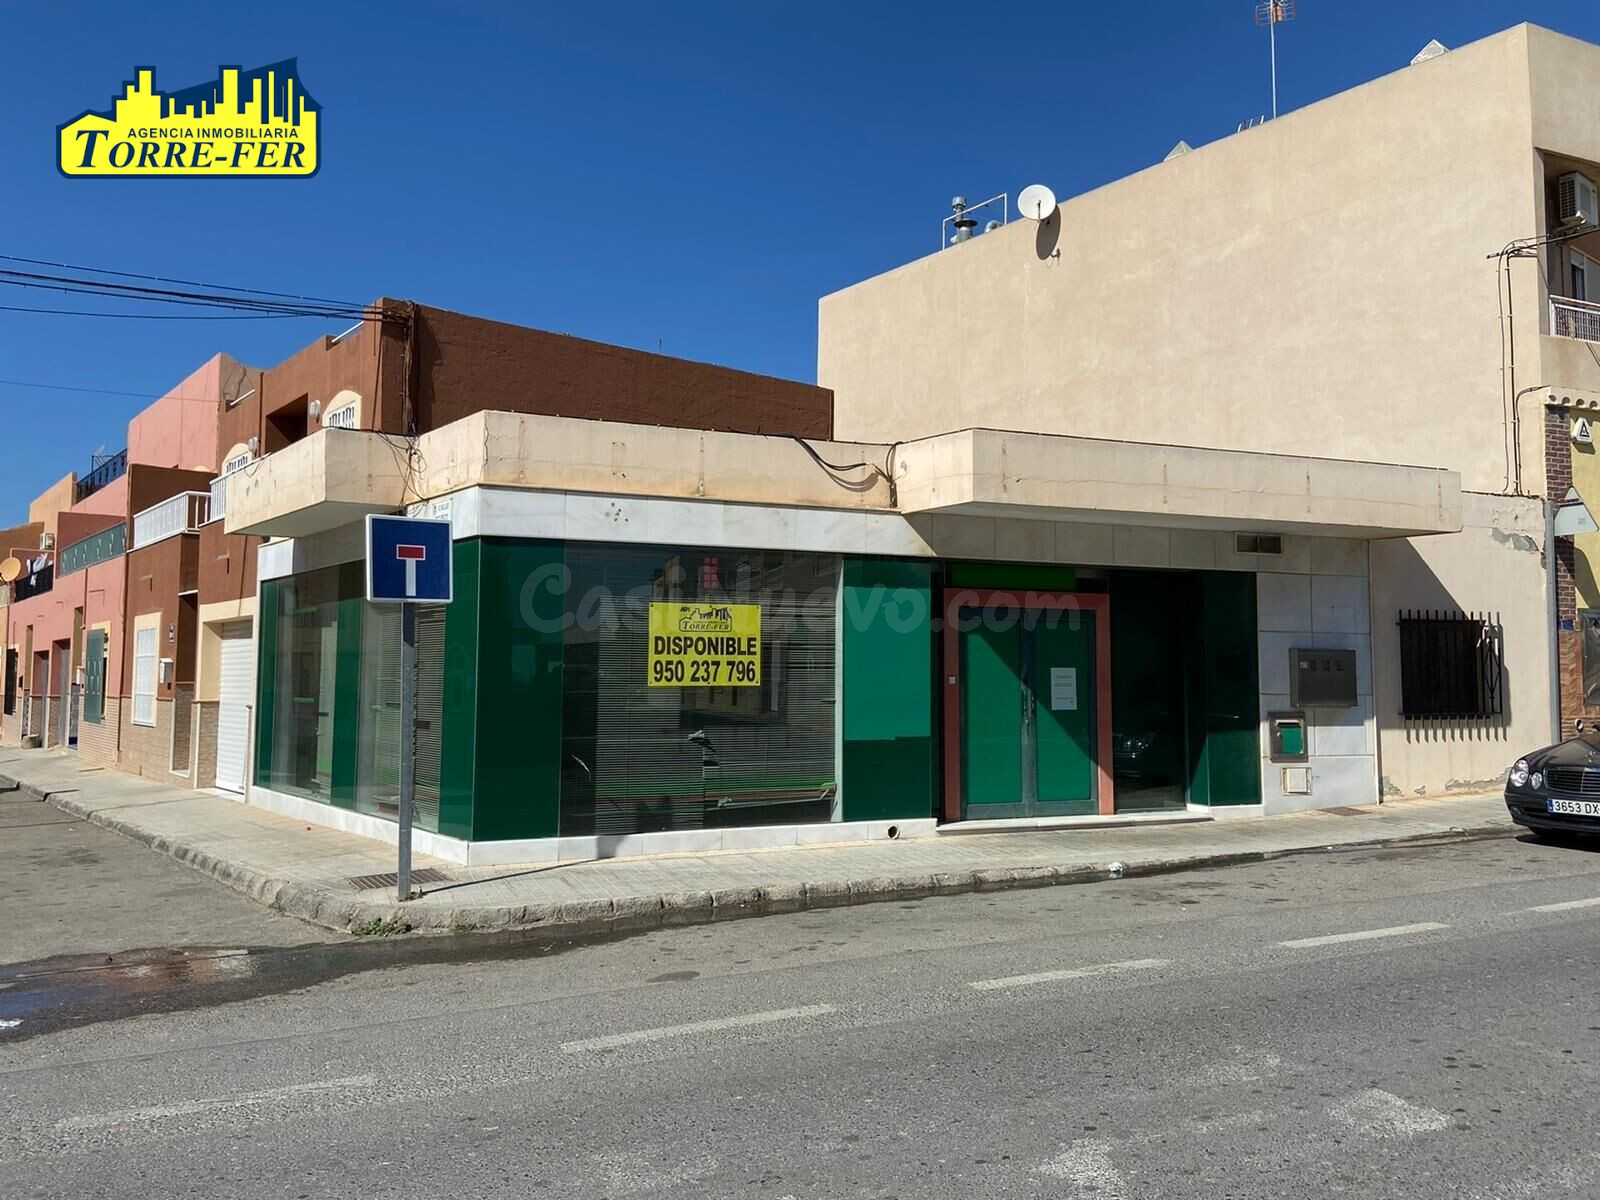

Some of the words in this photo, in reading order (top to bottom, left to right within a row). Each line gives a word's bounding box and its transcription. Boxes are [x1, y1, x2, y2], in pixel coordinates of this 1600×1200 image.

[654, 636, 757, 655] DISPONIBLE
[653, 660, 685, 682] 950
[690, 660, 721, 682] 237
[726, 660, 756, 682] 796
[1554, 800, 1582, 813] 3653
[1584, 803, 1600, 815] DX
